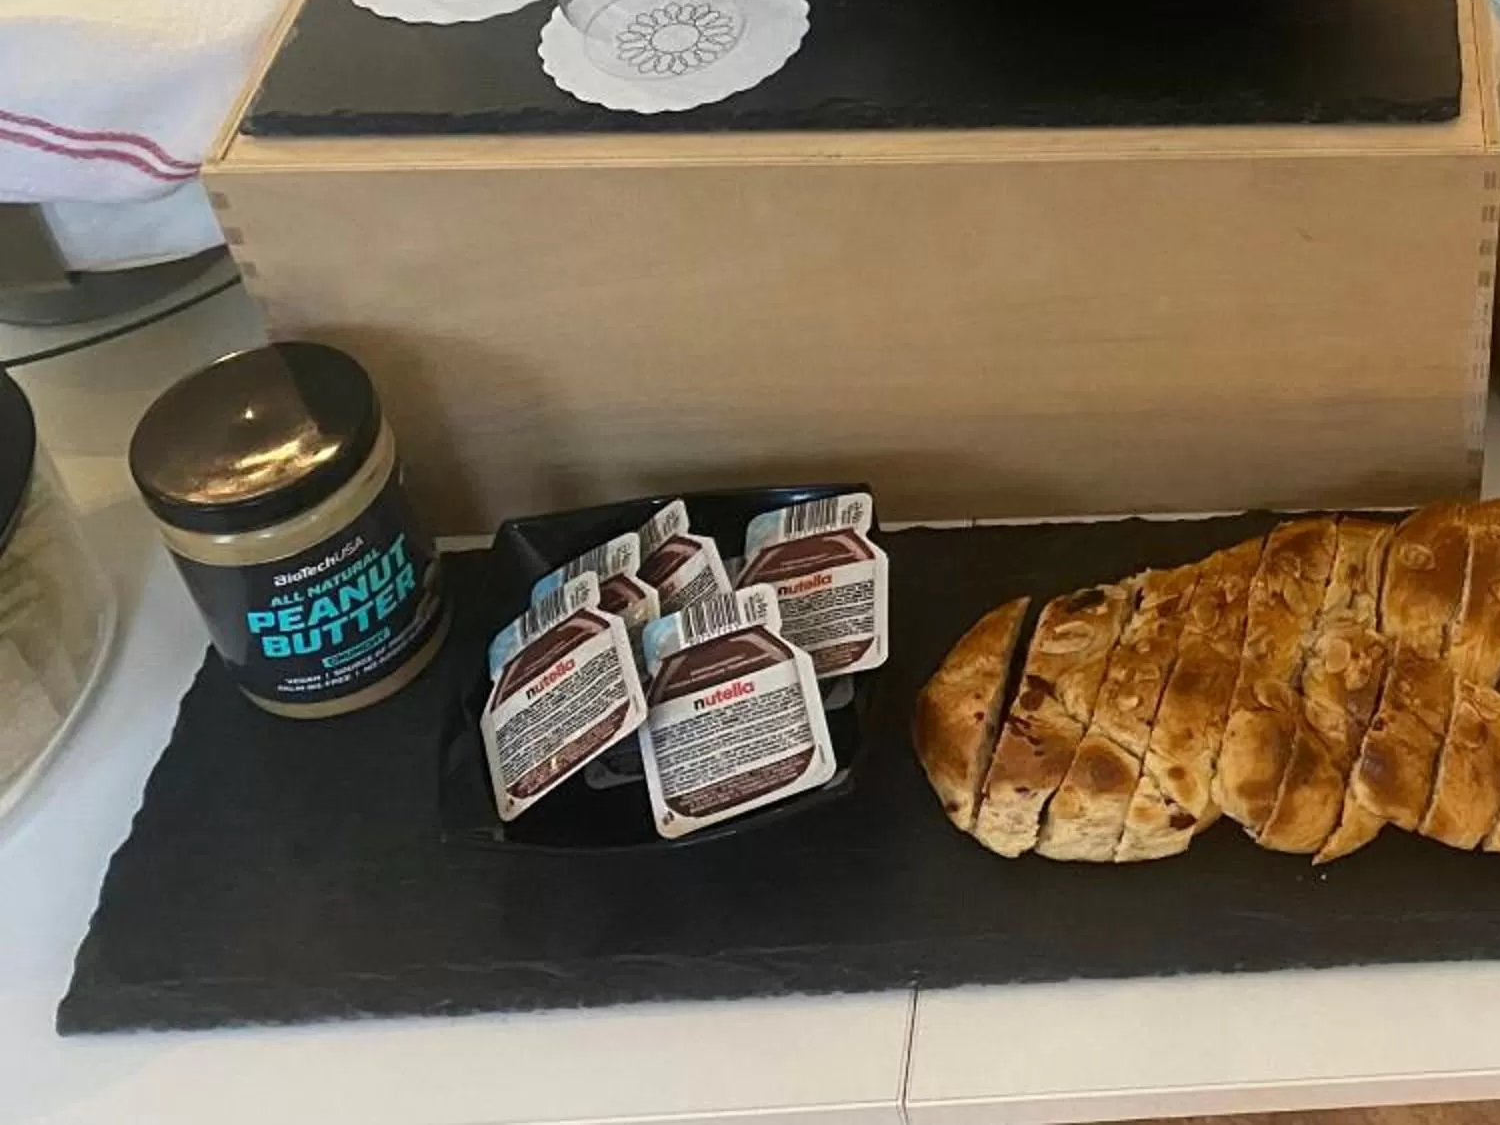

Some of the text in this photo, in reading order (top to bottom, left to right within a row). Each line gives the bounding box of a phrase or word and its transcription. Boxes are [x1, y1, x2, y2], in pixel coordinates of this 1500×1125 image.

[247, 532, 406, 634] PEANUT
[270, 548, 381, 608] ALL NATURAL
[273, 535, 364, 587] BioTechUSA
[778, 574, 833, 596] nutella
[261, 562, 417, 658] BUTTER
[525, 657, 576, 701] nutella
[693, 679, 755, 711] nutella
